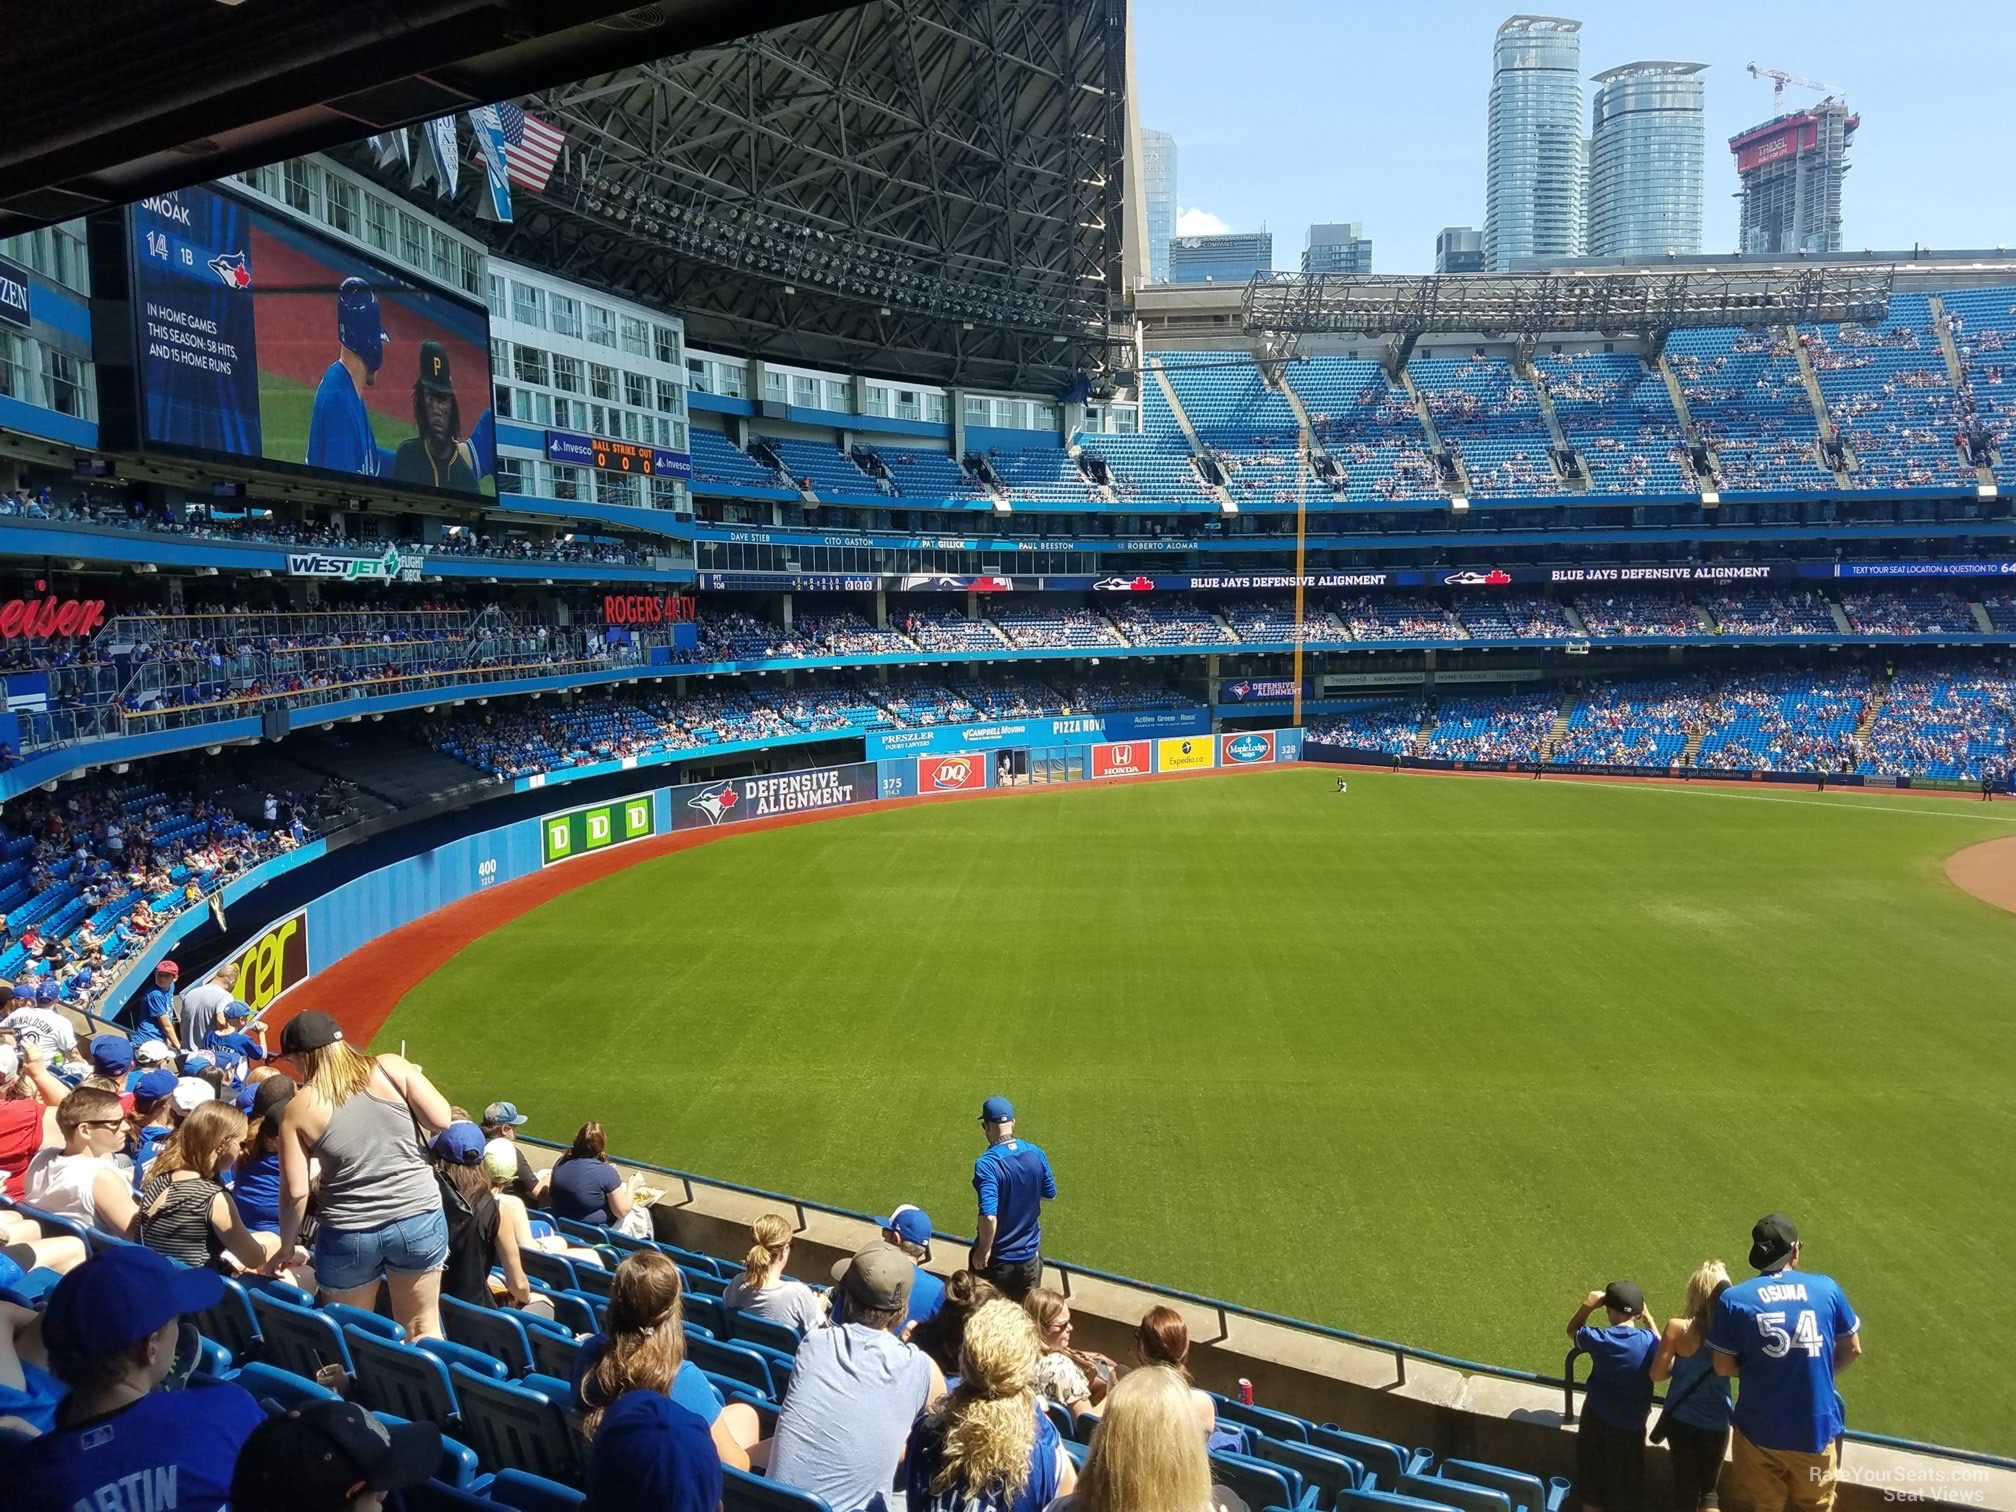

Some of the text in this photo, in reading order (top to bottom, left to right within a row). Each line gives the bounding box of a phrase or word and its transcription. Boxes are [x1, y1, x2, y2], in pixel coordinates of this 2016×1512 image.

[142, 197, 190, 226] SMOAK
[146, 231, 193, 266] 14 1B
[0, 276, 28, 312] ZEN
[147, 302, 217, 335] IN HOME GAMES
[148, 322, 238, 361] THIS SEASON: 58 HITS,
[149, 342, 232, 375] AND 15 HOME RUNS
[563, 441, 592, 456] Invesco
[592, 440, 653, 459] BALL STRIKE OUT
[666, 458, 691, 472] Invesco
[730, 532, 771, 543] DAVE STIEB
[824, 536, 874, 547] CITO GASTON
[922, 540, 965, 549] PAT GILLICK
[1018, 541, 1074, 550] PAUL BEESTON
[1127, 542, 1164, 550] ROBERTO
[1166, 542, 1199, 550] ALOMAR
[292, 556, 383, 578] WESTJET
[400, 555, 425, 569] FLIGHT
[404, 569, 423, 582] DECK
[1551, 566, 1771, 581] BLUE JAYS DEFENSIVE ALIGNMENT
[1852, 566, 1868, 575] TEXT
[1868, 566, 1889, 575] YOUR
[1889, 566, 1906, 574] SEAT
[1906, 565, 1943, 574] LOCATION
[1949, 564, 1987, 573] QUESTION
[1987, 564, 1998, 573] TO
[712, 574, 723, 582] PIT
[1190, 574, 1387, 589] BLUE JAYS DEFENSIVE ALIGNMENT
[712, 582, 726, 590] TOR
[604, 595, 662, 624] ROGERS
[680, 596, 696, 622] TV
[1252, 681, 1296, 691] DEFENSIVE
[1257, 687, 1302, 697] ALIGNMENT
[1053, 718, 1106, 735] PIZZA NOVA
[1134, 715, 1156, 724] Active
[881, 731, 935, 744] PRESZLER
[905, 741, 931, 749] LAWYERS
[1280, 745, 1296, 754] 328
[1169, 755, 1204, 766] Expedia.ca
[939, 764, 966, 781] DQ
[1104, 765, 1140, 775] HONDA
[745, 771, 839, 800] DEFENSIVE
[883, 778, 902, 789] 375
[756, 784, 853, 815] ALIGNMENT
[478, 858, 497, 876] 400
[1757, 1283, 1808, 1304] OSUNA
[1756, 1309, 1824, 1358] 54
